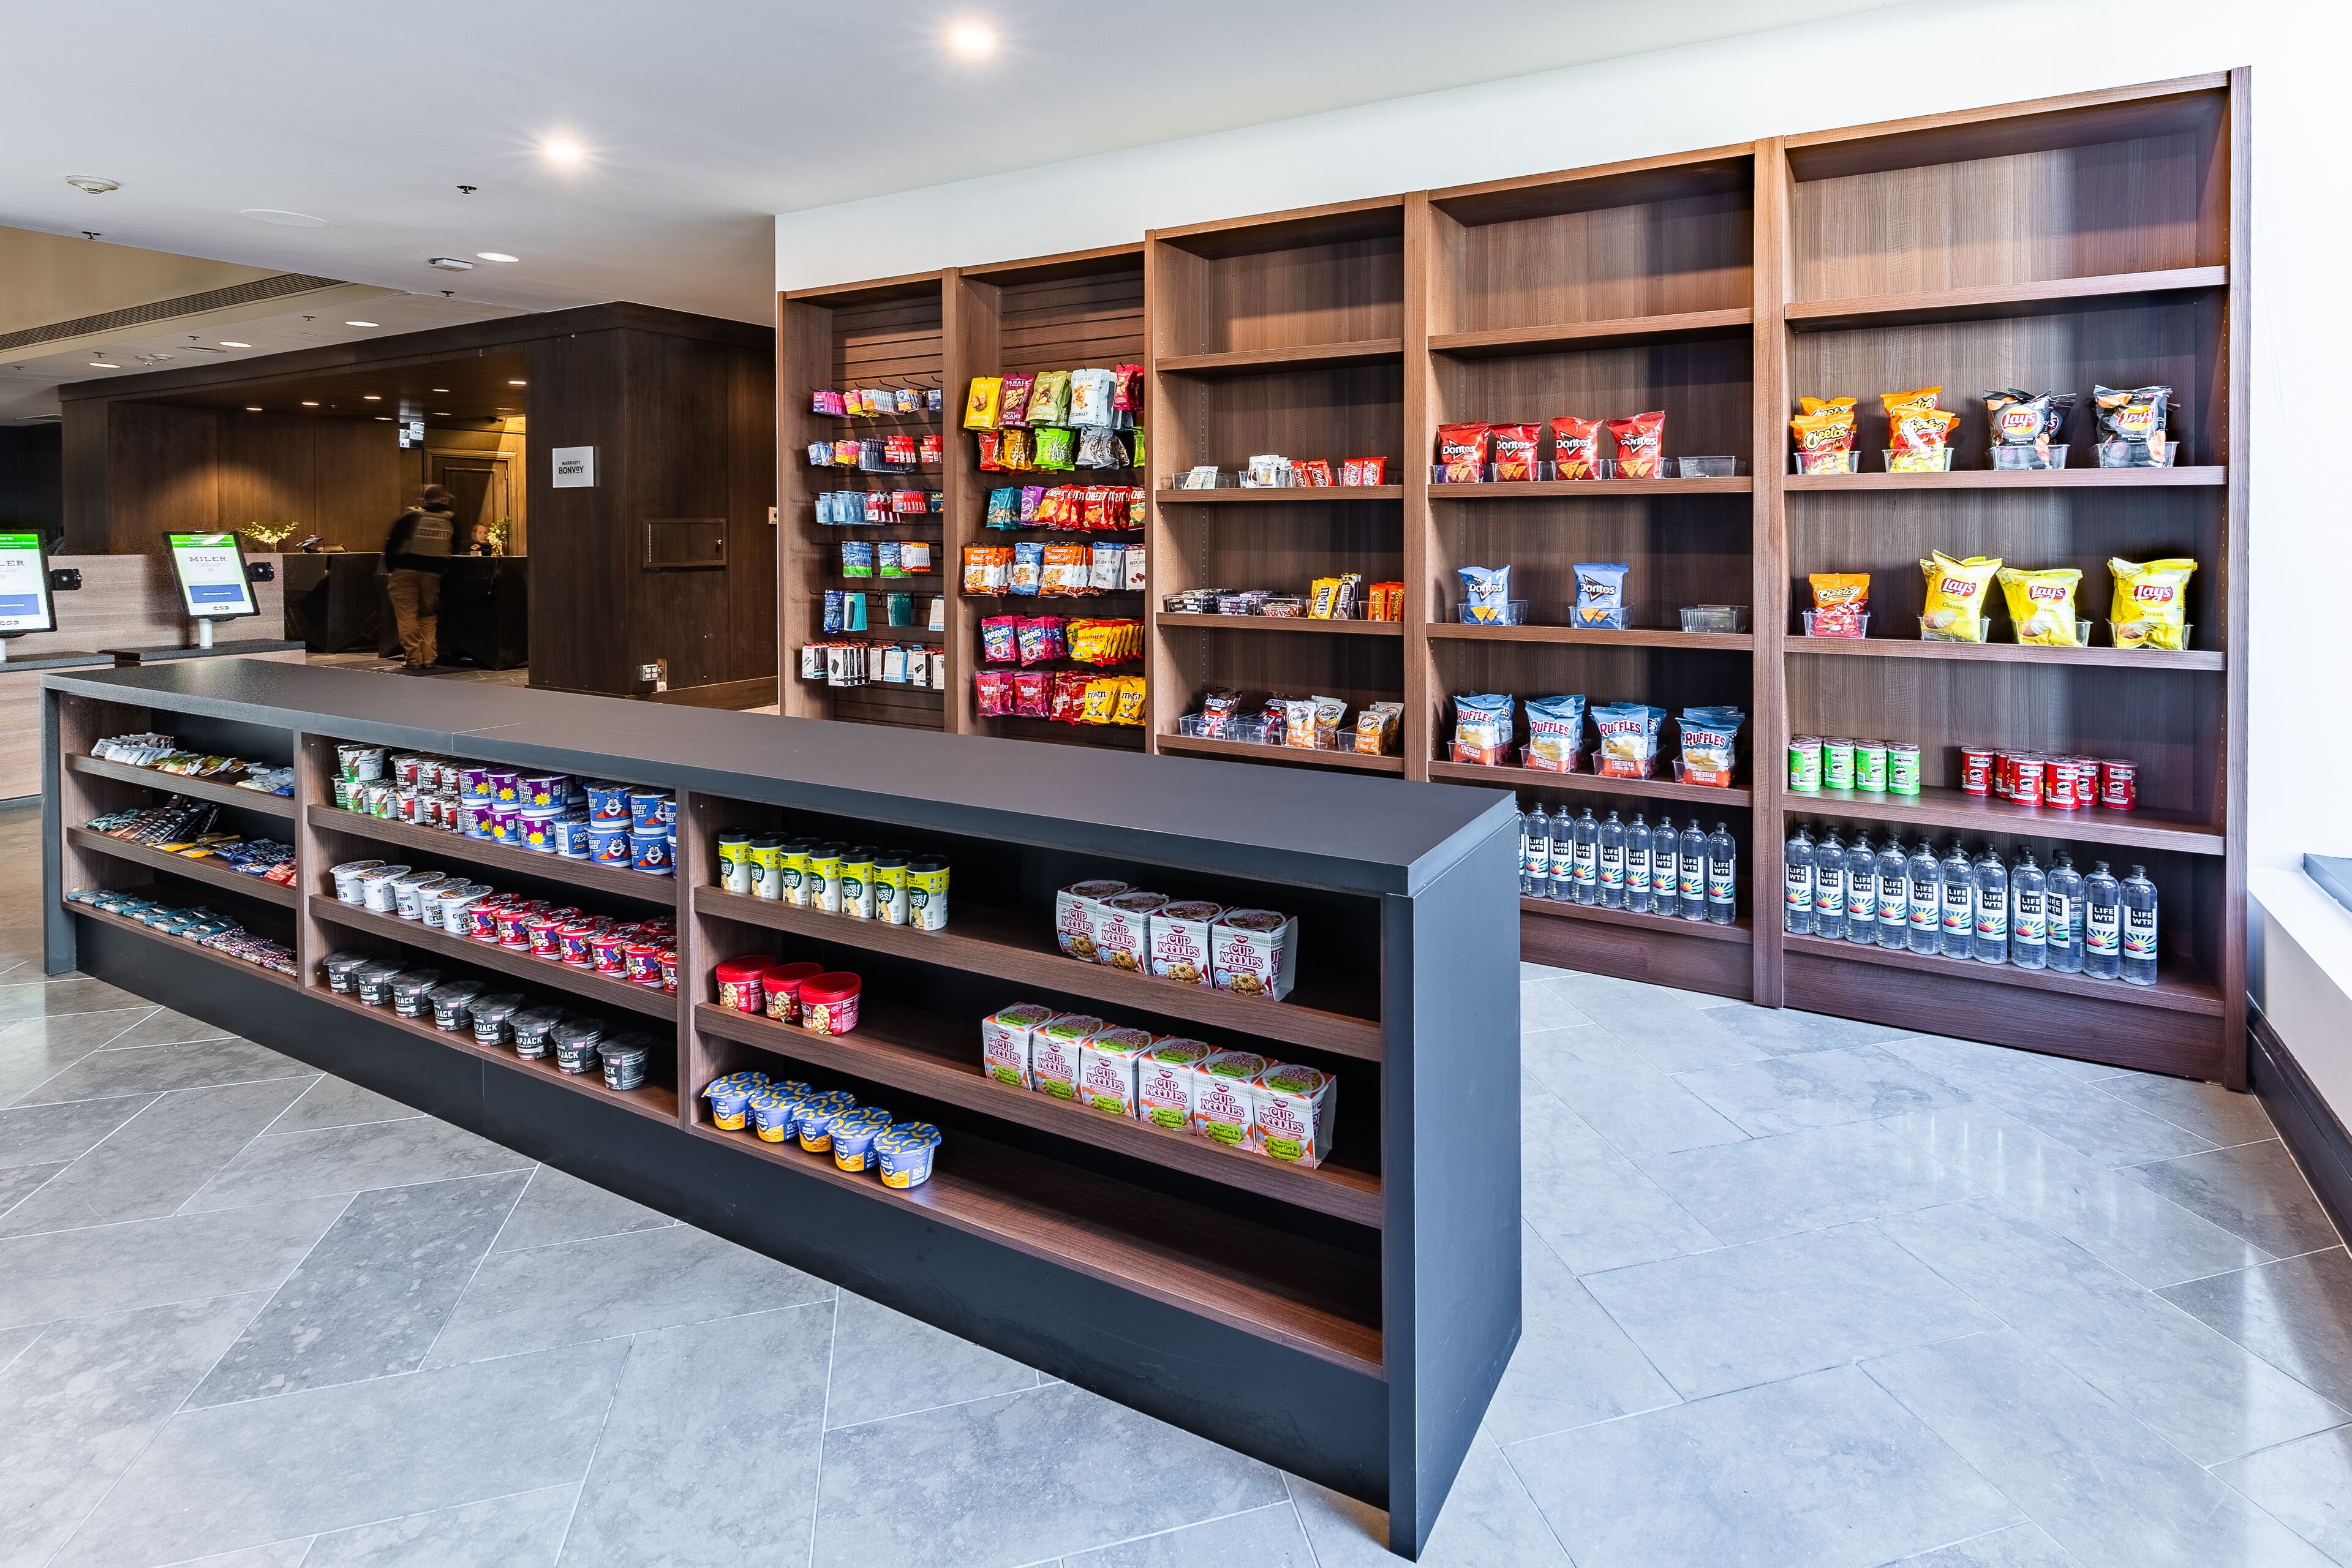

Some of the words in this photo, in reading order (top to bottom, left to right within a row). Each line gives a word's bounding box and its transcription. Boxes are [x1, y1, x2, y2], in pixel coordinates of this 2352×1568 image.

[2003, 413, 2036, 428] Lay's
[2120, 409, 2154, 424] Lay's
[1556, 439, 1593, 449] Doritos
[1806, 426, 1846, 450] Cheetos
[1442, 445, 1476, 454] Doritos
[1497, 440, 1530, 450] Doritos
[420, 528, 450, 538] SECURITY
[1469, 583, 1504, 593] Doritos
[1580, 583, 1616, 595] Doritos
[1942, 578, 1976, 596] Lay's
[2032, 586, 2065, 601] Lay's
[2136, 585, 2173, 602] Lay's
[1819, 587, 1860, 601] Cheetos
[1942, 602, 1965, 611] Classic
[1457, 709, 1493, 723] RUFFLES
[1531, 721, 1569, 736] RUFFLES
[1685, 732, 1725, 747] RUFFLES
[1536, 758, 1558, 766] CHEDDAR
[1069, 909, 1087, 921] CUP
[1061, 918, 1095, 933] NOODLES
[1108, 923, 1129, 936] CUP
[1101, 931, 1136, 948] NOODLES
[1167, 934, 1191, 946] CUP
[1158, 943, 1199, 957] NOODLES
[1229, 944, 1254, 956] CUP
[1219, 952, 1263, 968] NOODLES
[517, 1036, 542, 1045] APJACK
[995, 1038, 1014, 1051] CUP
[989, 1044, 1020, 1065] NOODLES
[1045, 1051, 1065, 1064] CUP
[1038, 1058, 1072, 1077] NOODLES
[1095, 1066, 1117, 1079] CUP
[1087, 1072, 1125, 1091] NOODLES
[1155, 1077, 1178, 1090] CUP
[1091, 1086, 1112, 1095] CHICKEN
[1145, 1085, 1187, 1102] NOODLES
[1152, 1098, 1173, 1106] CHICKEN
[1210, 1092, 1235, 1104] CUP
[1200, 1099, 1245, 1117] NOODLES
[1268, 1106, 1294, 1120] CUP
[1207, 1112, 1230, 1120] CHICKEN
[1259, 1113, 1304, 1133] NOODLES
[1266, 1126, 1288, 1136] CHICKEN
